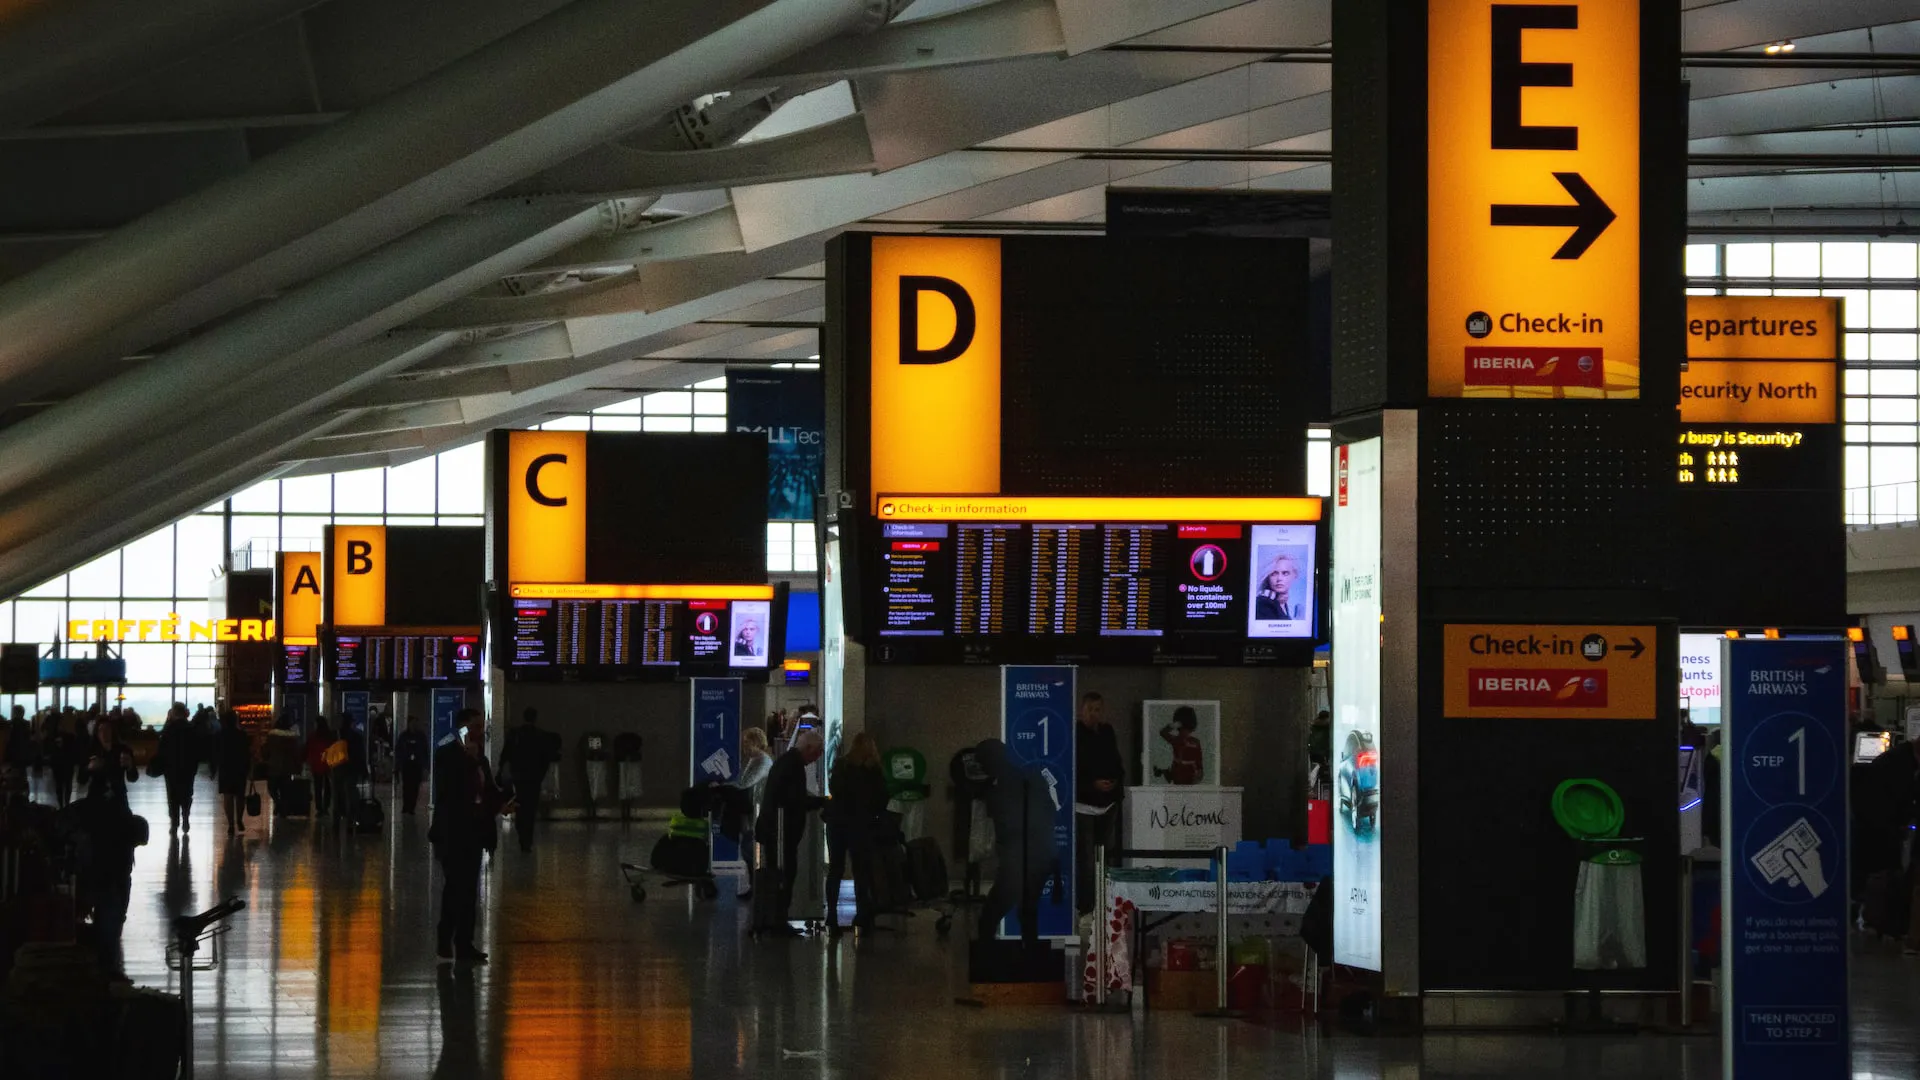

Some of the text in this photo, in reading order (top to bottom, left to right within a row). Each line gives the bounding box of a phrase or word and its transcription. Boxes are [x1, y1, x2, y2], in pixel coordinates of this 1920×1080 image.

[1491, 4, 1578, 150] E
[899, 275, 976, 365] D
[1500, 313, 1603, 333] Check-in
[1689, 316, 1817, 341] epartures
[1473, 357, 1535, 369] IBERIA
[1681, 381, 1817, 403] ecurity North
[1687, 431, 1721, 447] busy
[1724, 431, 1736, 445] is
[1738, 431, 1803, 447] Security?
[525, 453, 568, 507] C
[899, 503, 1027, 514] Check-in information
[1186, 525, 1207, 533] Security
[347, 540, 373, 575] B
[290, 564, 321, 595] A
[1199, 585, 1223, 593] liquids
[1196, 593, 1233, 601] containers
[1469, 634, 1574, 655] Check-in
[1681, 655, 1711, 664] ness
[1681, 669, 1713, 680] unts
[1750, 669, 1805, 682] BRITISH
[1016, 683, 1049, 691] BRITISH
[1478, 677, 1551, 691] IBERIA
[1748, 683, 1808, 695] AIRWAYS
[1014, 691, 1050, 699] AIRWAYS
[1680, 684, 1720, 699] utopil
[1016, 715, 1049, 756] STEP 1
[1752, 726, 1806, 796] STEP 1
[1150, 804, 1227, 829] Welcome
[1162, 888, 1215, 898] CONTACTLESS
[1230, 891, 1266, 900] NATIONS
[1754, 917, 1773, 929] you
[1775, 916, 1788, 927] do
[1744, 929, 1767, 940] have
[1768, 932, 1776, 940] a
[1777, 929, 1817, 942] boarding
[1763, 944, 1782, 953] one
[1749, 1013, 1836, 1024] THEN PROCEED
[1765, 1027, 1822, 1038] TO STEP 2
